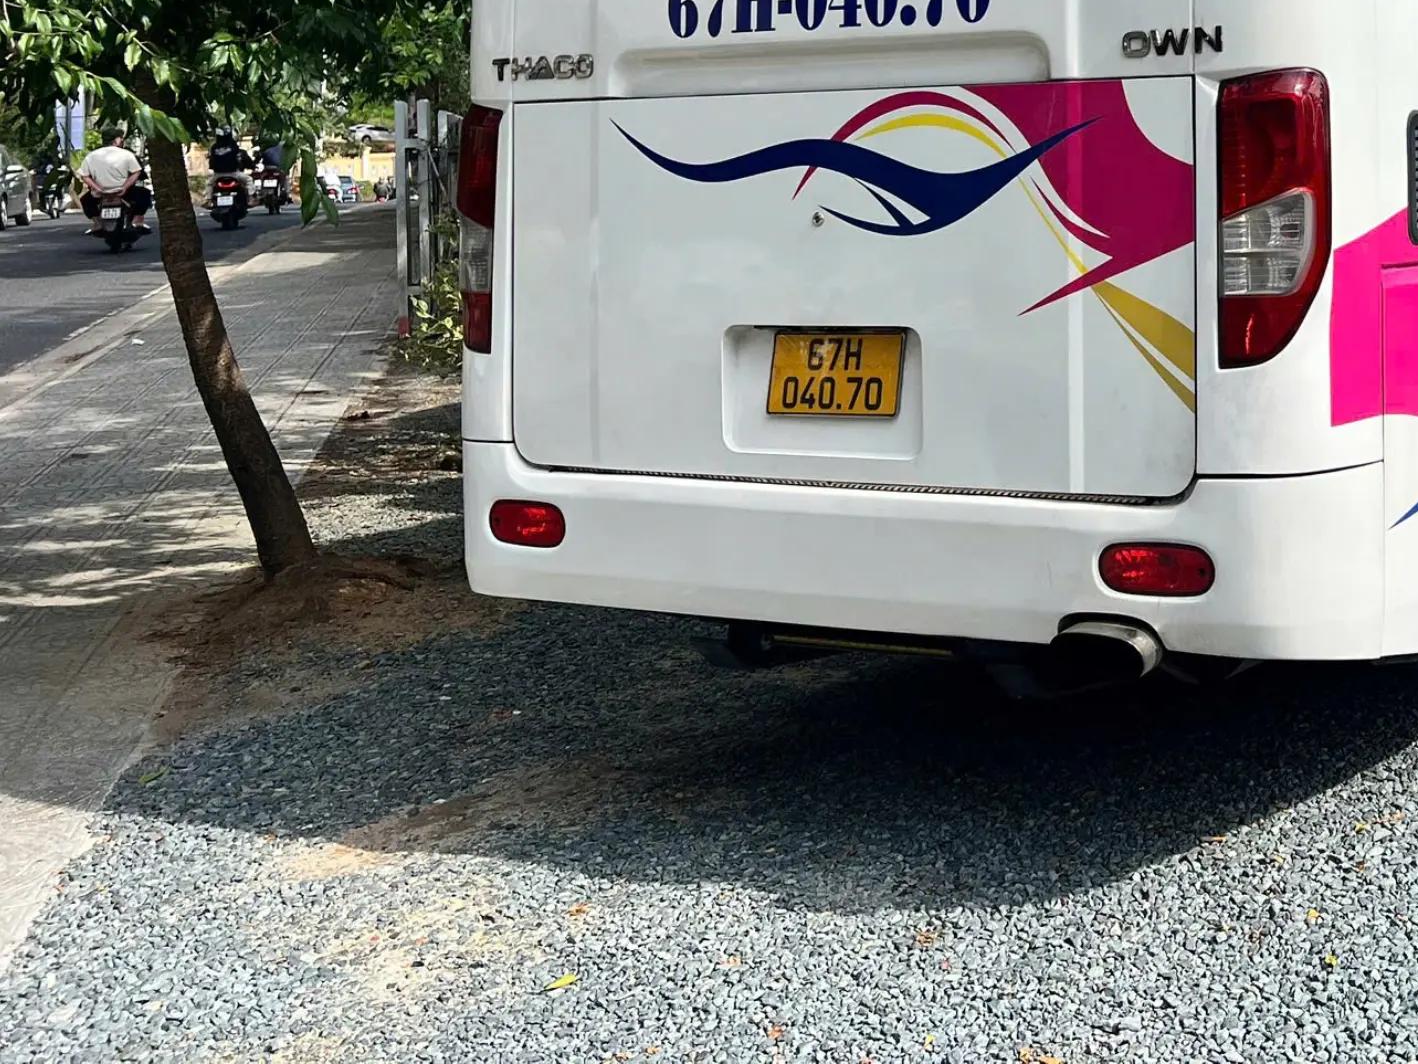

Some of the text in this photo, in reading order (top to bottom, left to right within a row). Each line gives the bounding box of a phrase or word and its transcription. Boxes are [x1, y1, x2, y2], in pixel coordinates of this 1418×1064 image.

[1122, 25, 1223, 58] OWN
[492, 54, 594, 82] THACO
[807, 337, 863, 371] 67H
[782, 376, 883, 411] 040.70
